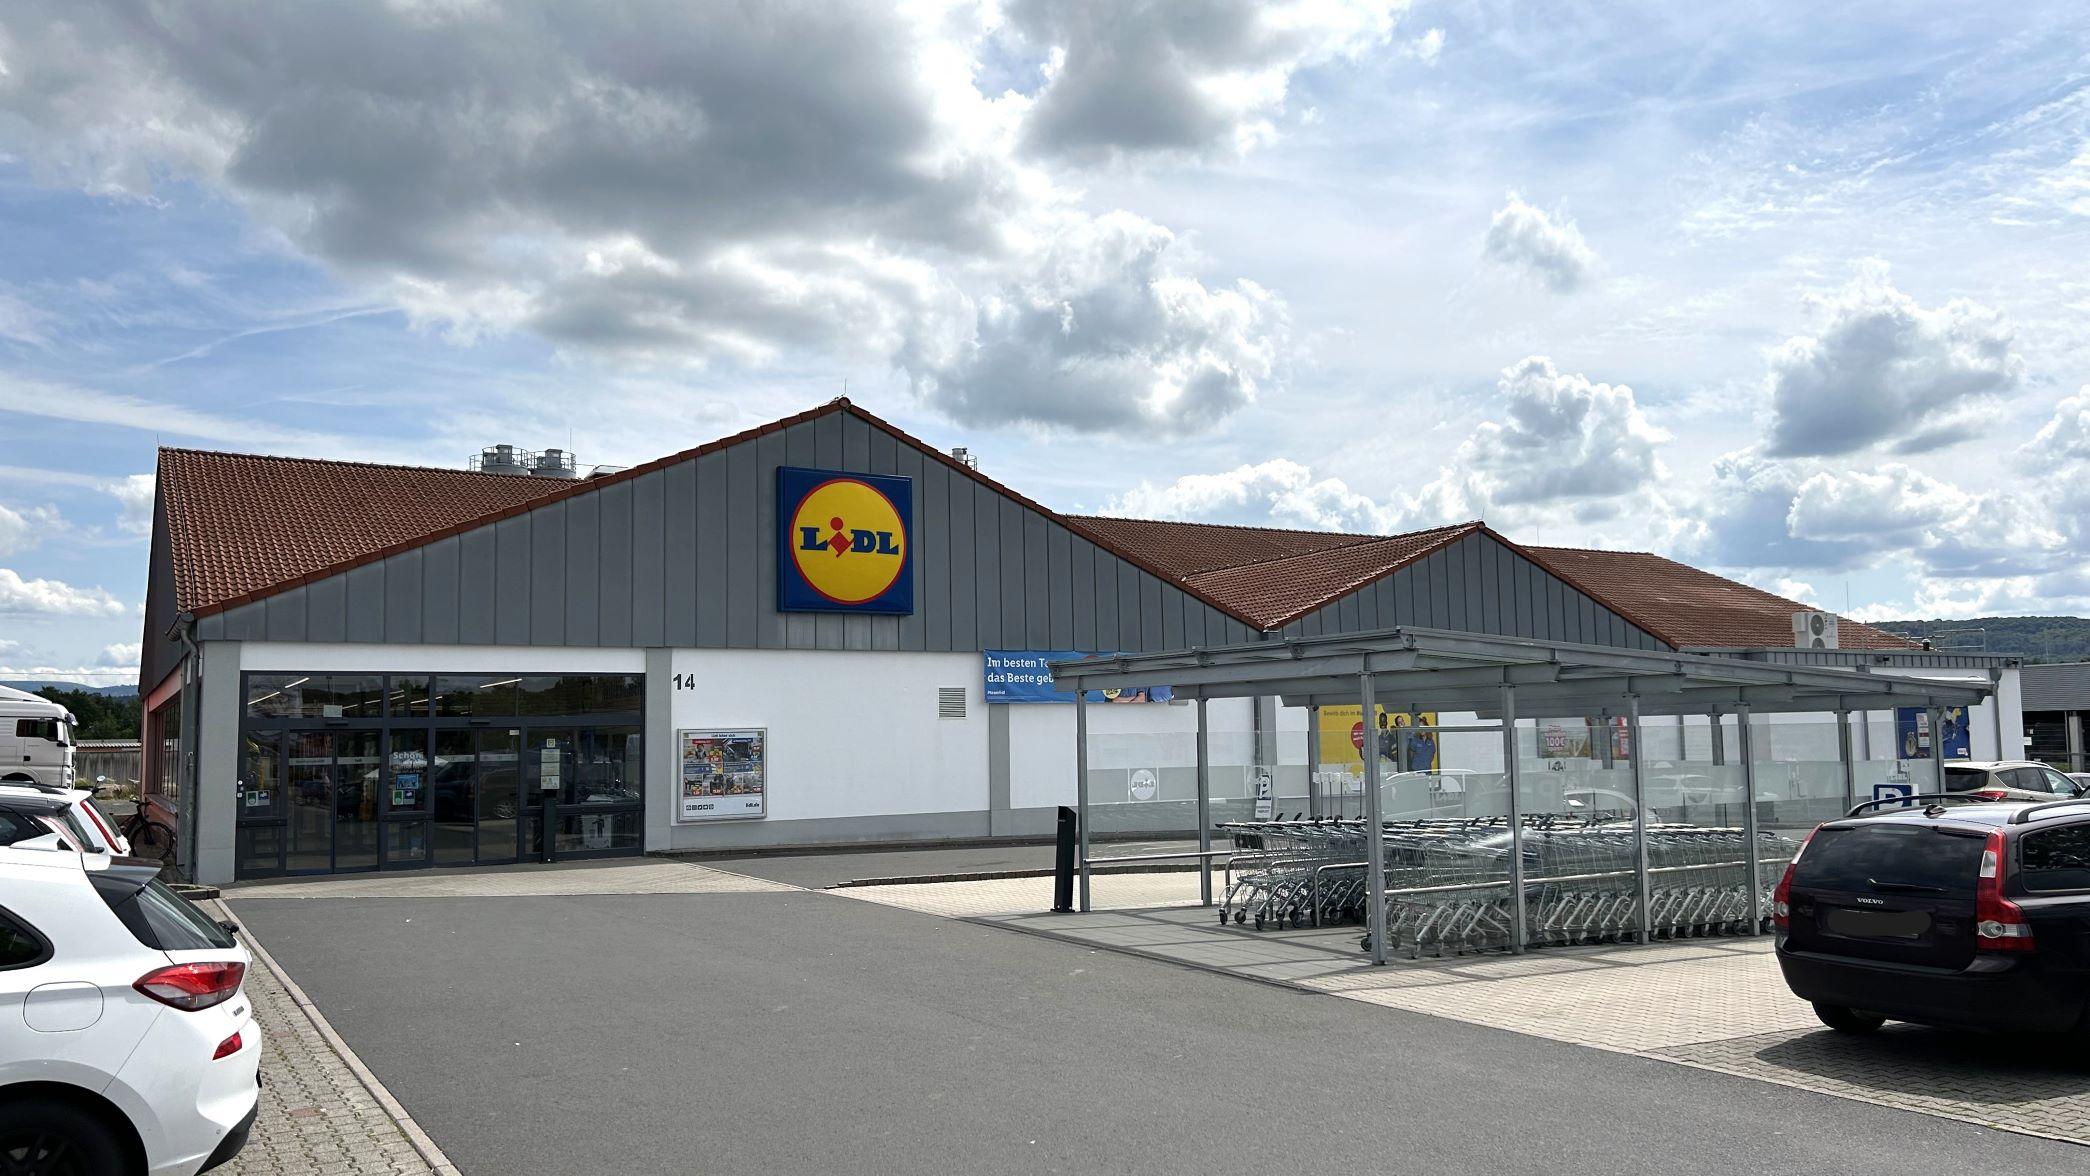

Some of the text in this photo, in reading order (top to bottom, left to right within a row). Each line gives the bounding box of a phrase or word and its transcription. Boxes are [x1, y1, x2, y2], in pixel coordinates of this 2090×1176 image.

[987, 656, 1001, 668] Im
[1003, 657, 1037, 669] besten
[673, 673, 696, 690] 14
[987, 673, 1005, 684] das
[1007, 673, 1035, 684] Beste
[1856, 897, 1884, 905] VOLVO
